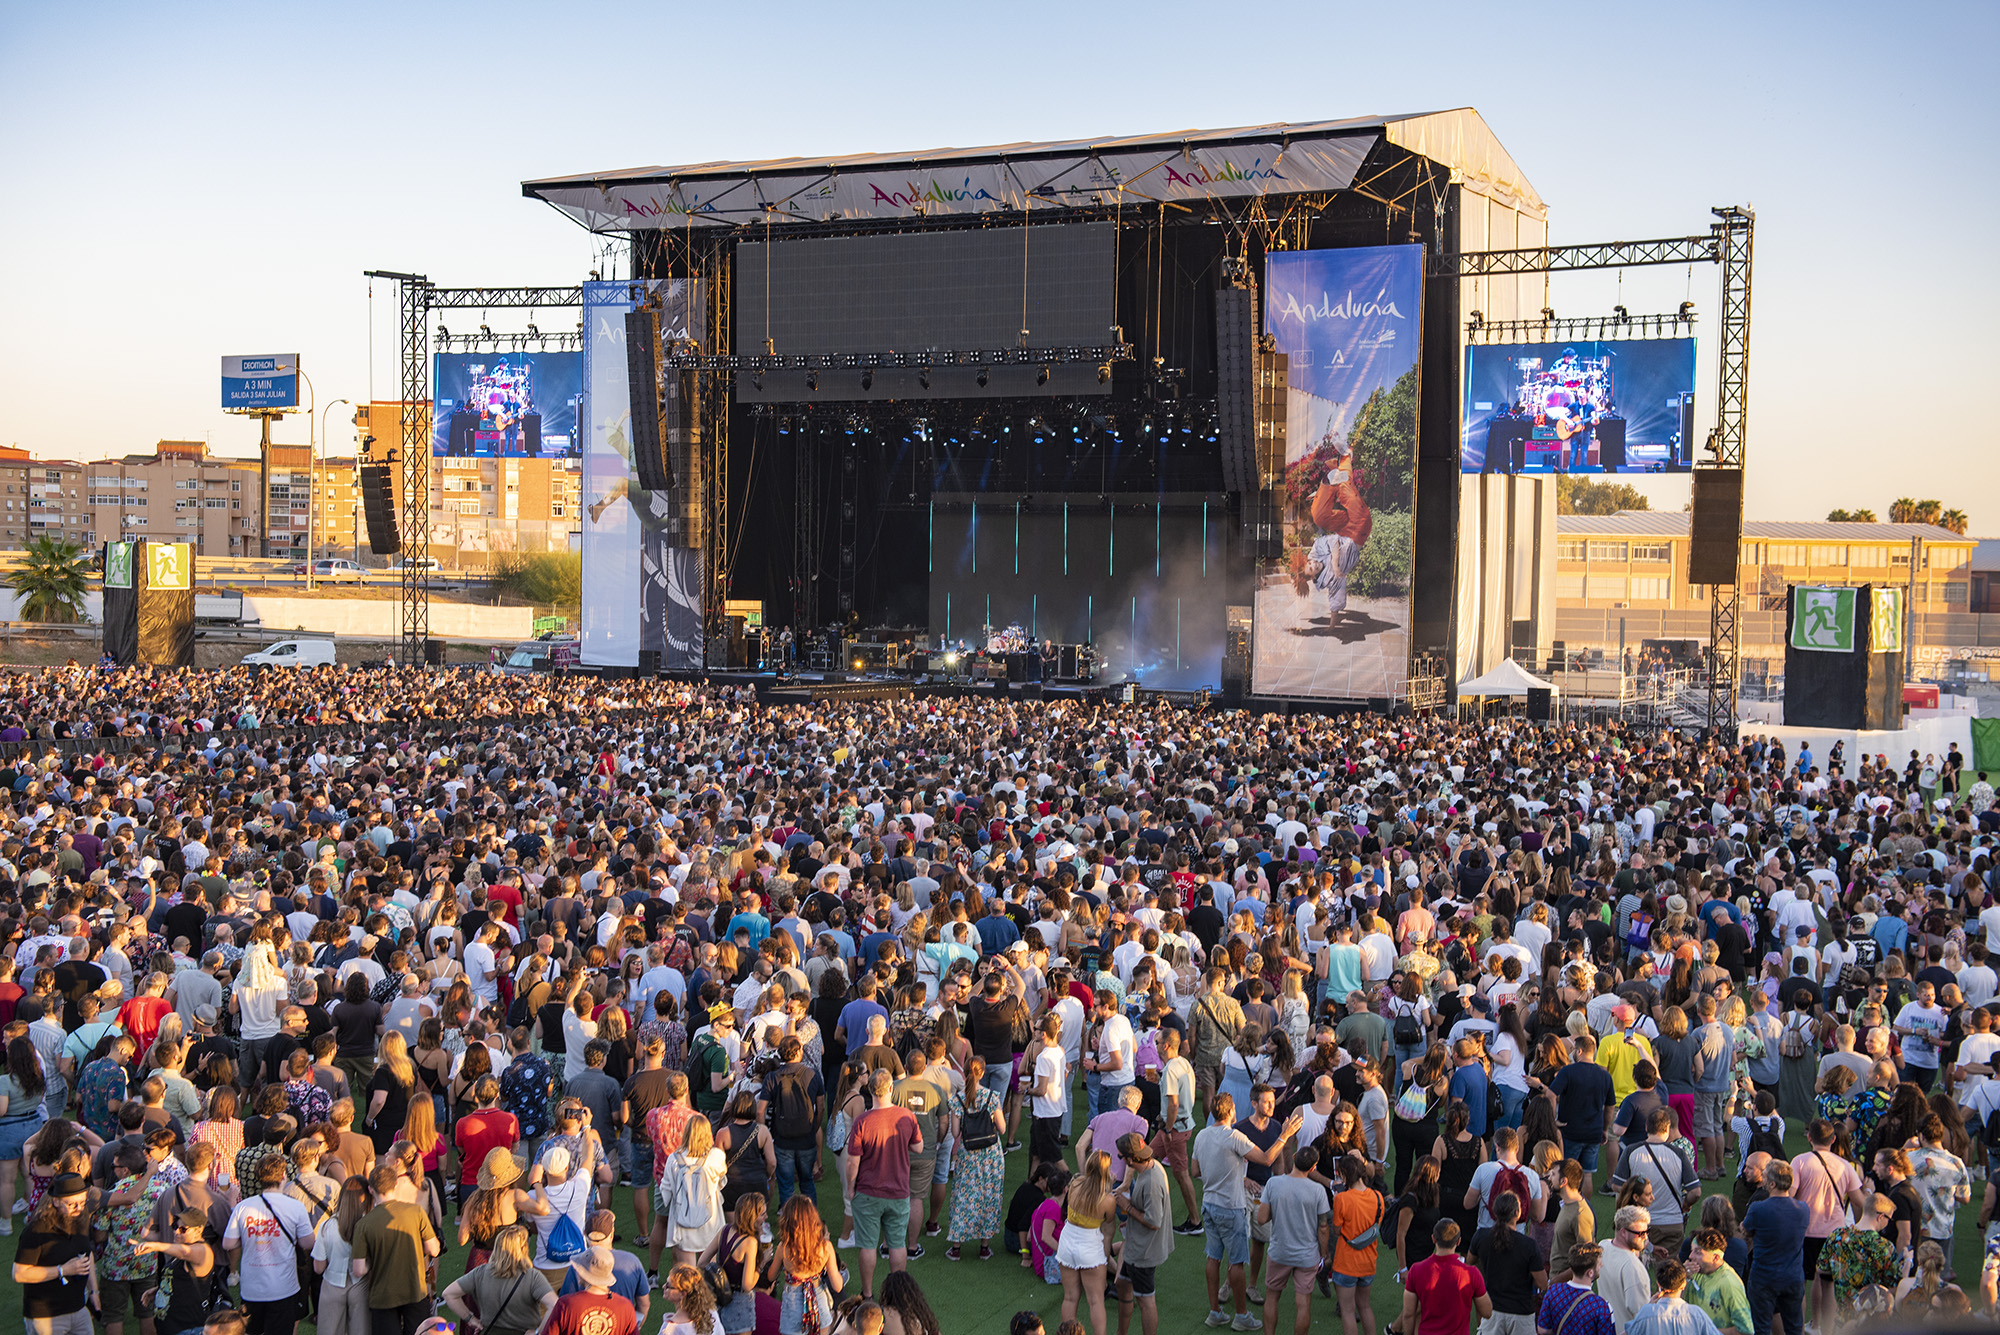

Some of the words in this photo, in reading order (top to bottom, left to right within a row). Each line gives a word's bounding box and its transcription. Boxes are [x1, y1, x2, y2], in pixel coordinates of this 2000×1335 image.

[1164, 158, 1289, 188] Andalucía
[868, 177, 1002, 208] Andalucía
[1281, 288, 1406, 323] Andalucía
[244, 361, 272, 370] DECATHLON
[244, 381, 250, 390] A
[251, 381, 256, 390] 3
[257, 380, 272, 390] MIN
